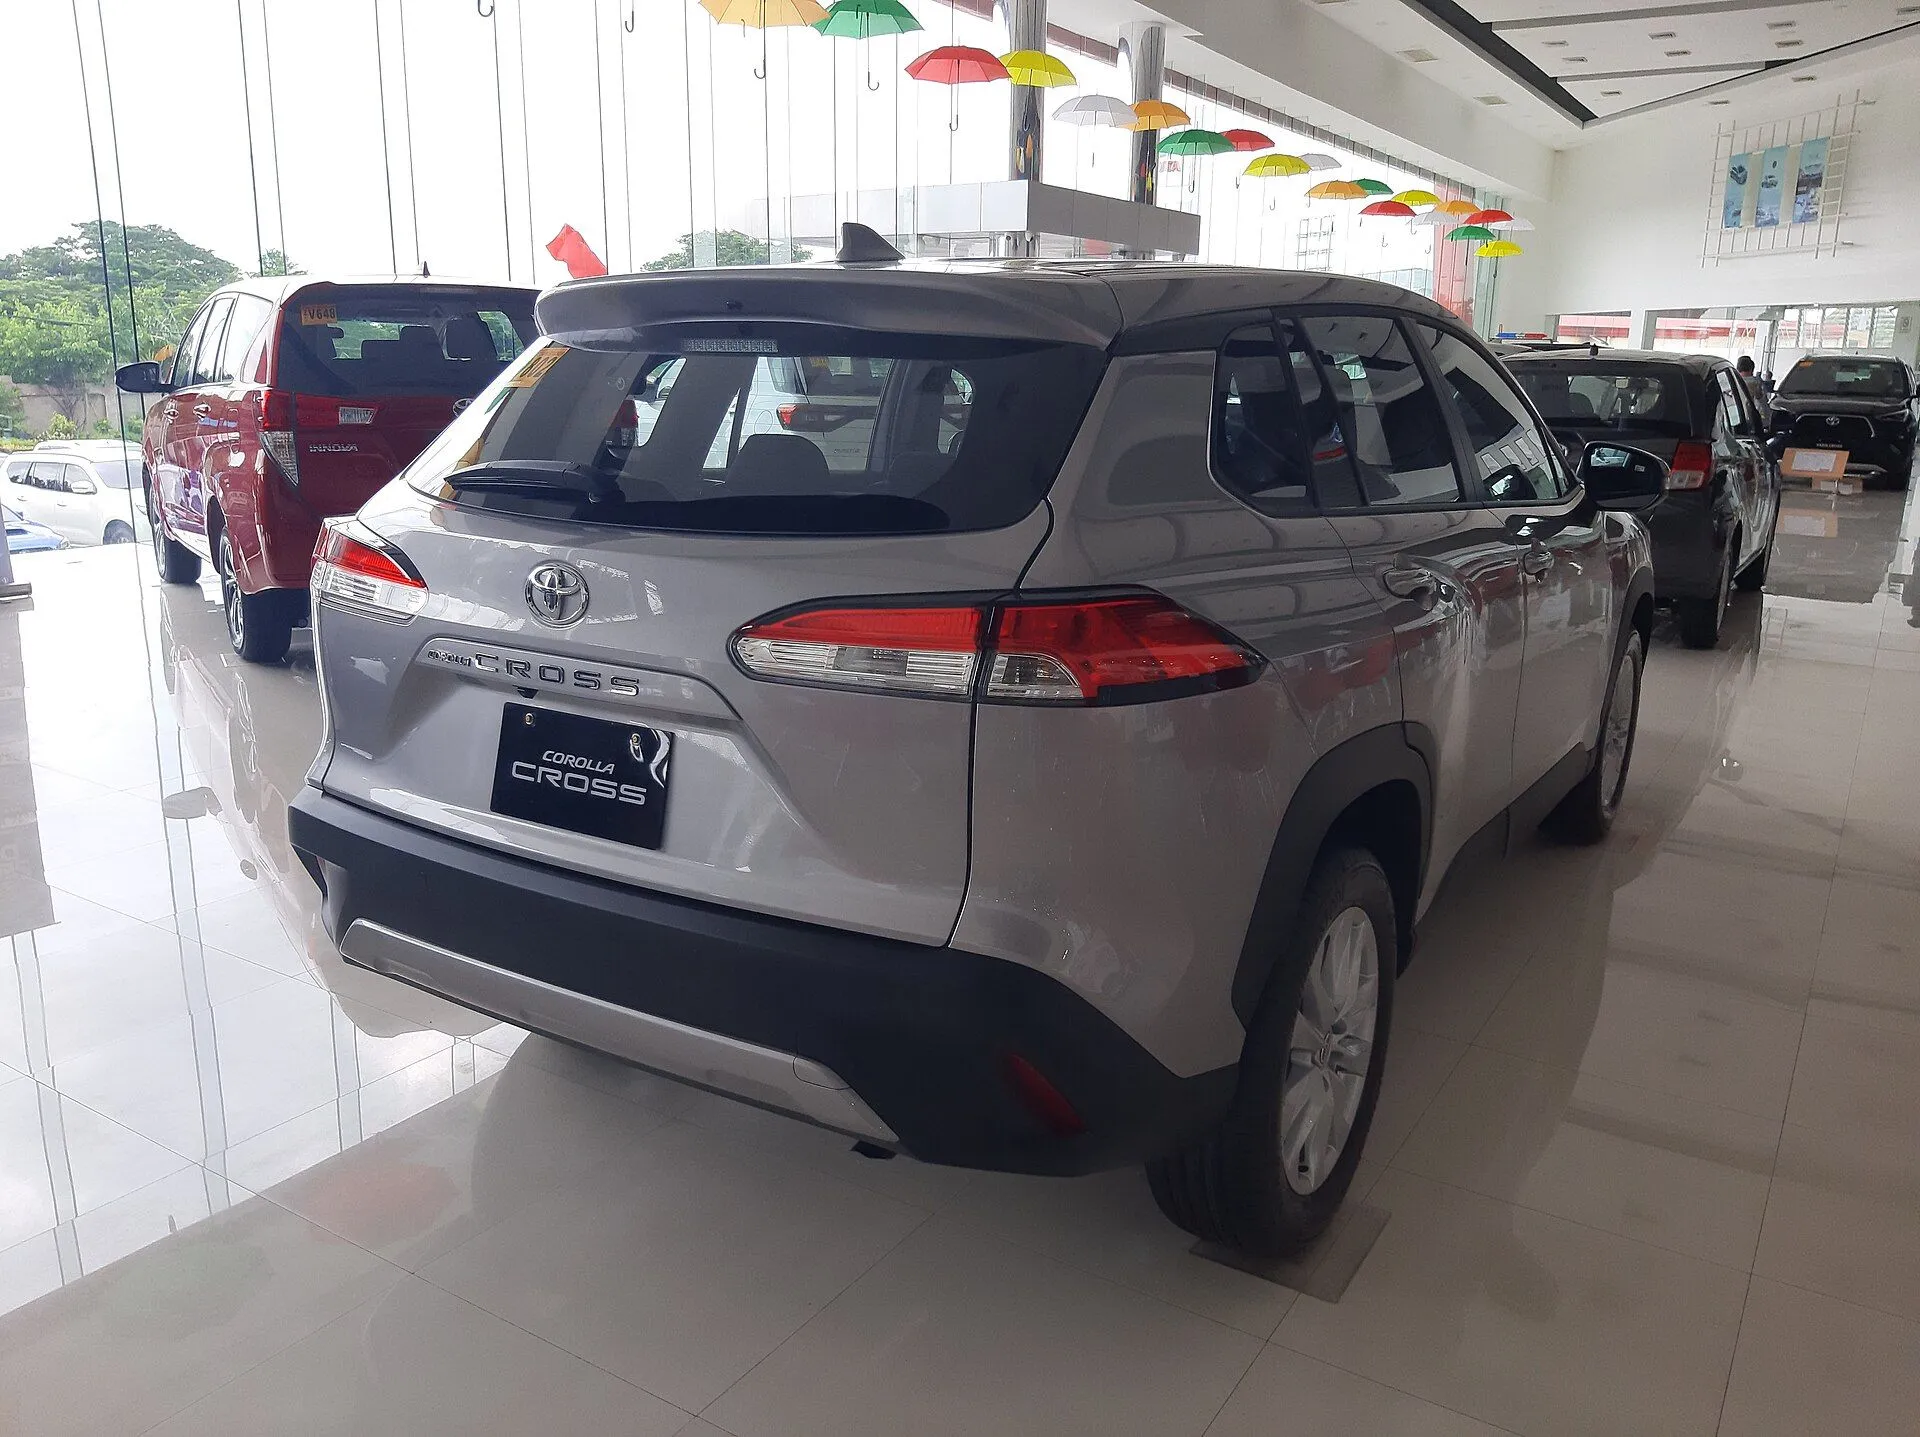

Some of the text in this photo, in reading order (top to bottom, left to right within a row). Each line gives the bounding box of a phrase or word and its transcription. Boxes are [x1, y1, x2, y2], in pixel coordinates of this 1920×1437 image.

[308, 308, 336, 320] V648
[475, 652, 640, 697] CROSS
[542, 750, 616, 775] COROLLA
[511, 760, 647, 806] CROSS
